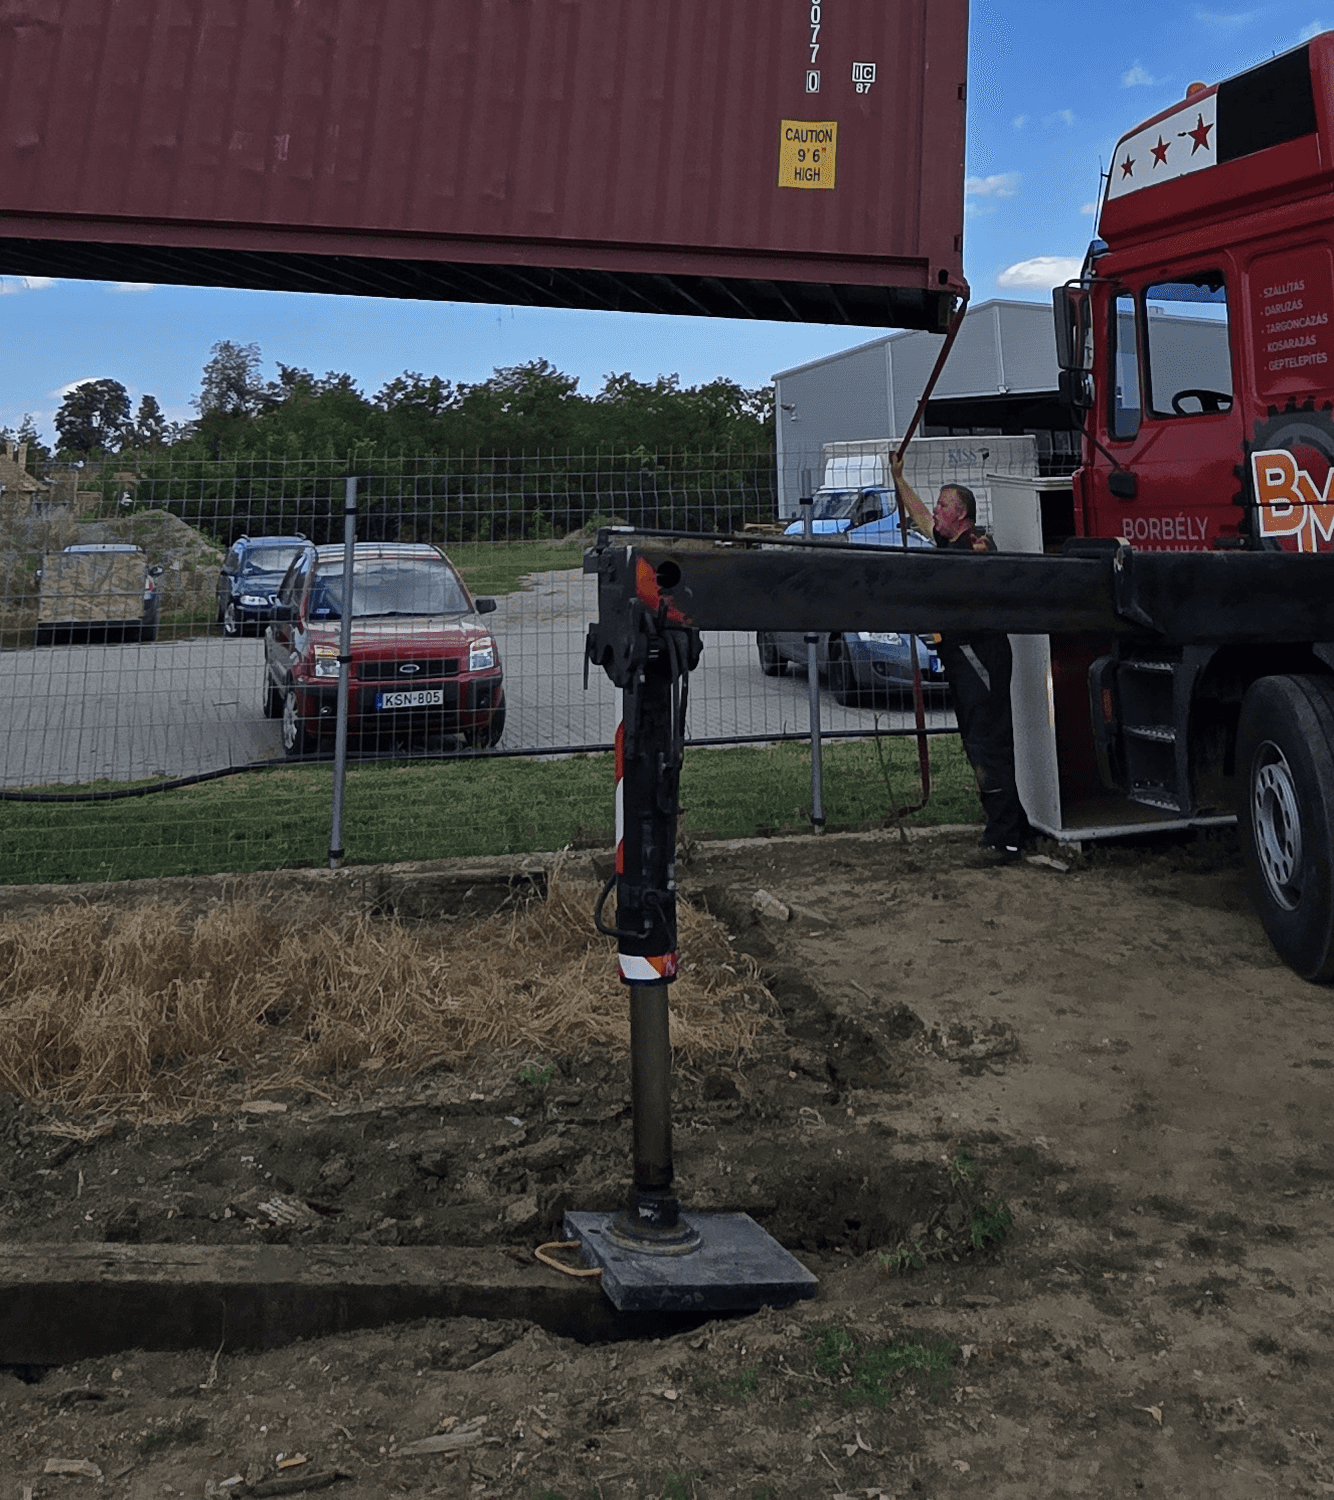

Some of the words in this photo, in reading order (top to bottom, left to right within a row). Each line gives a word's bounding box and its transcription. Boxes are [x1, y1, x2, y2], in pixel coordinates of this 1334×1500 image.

[808, 72, 819, 92] 0
[856, 83, 871, 94] 87
[785, 128, 833, 143] CAUTION
[794, 166, 821, 181] HIGH
[1122, 511, 1208, 541] BORBÉLY
[385, 691, 440, 706] KSN-805
